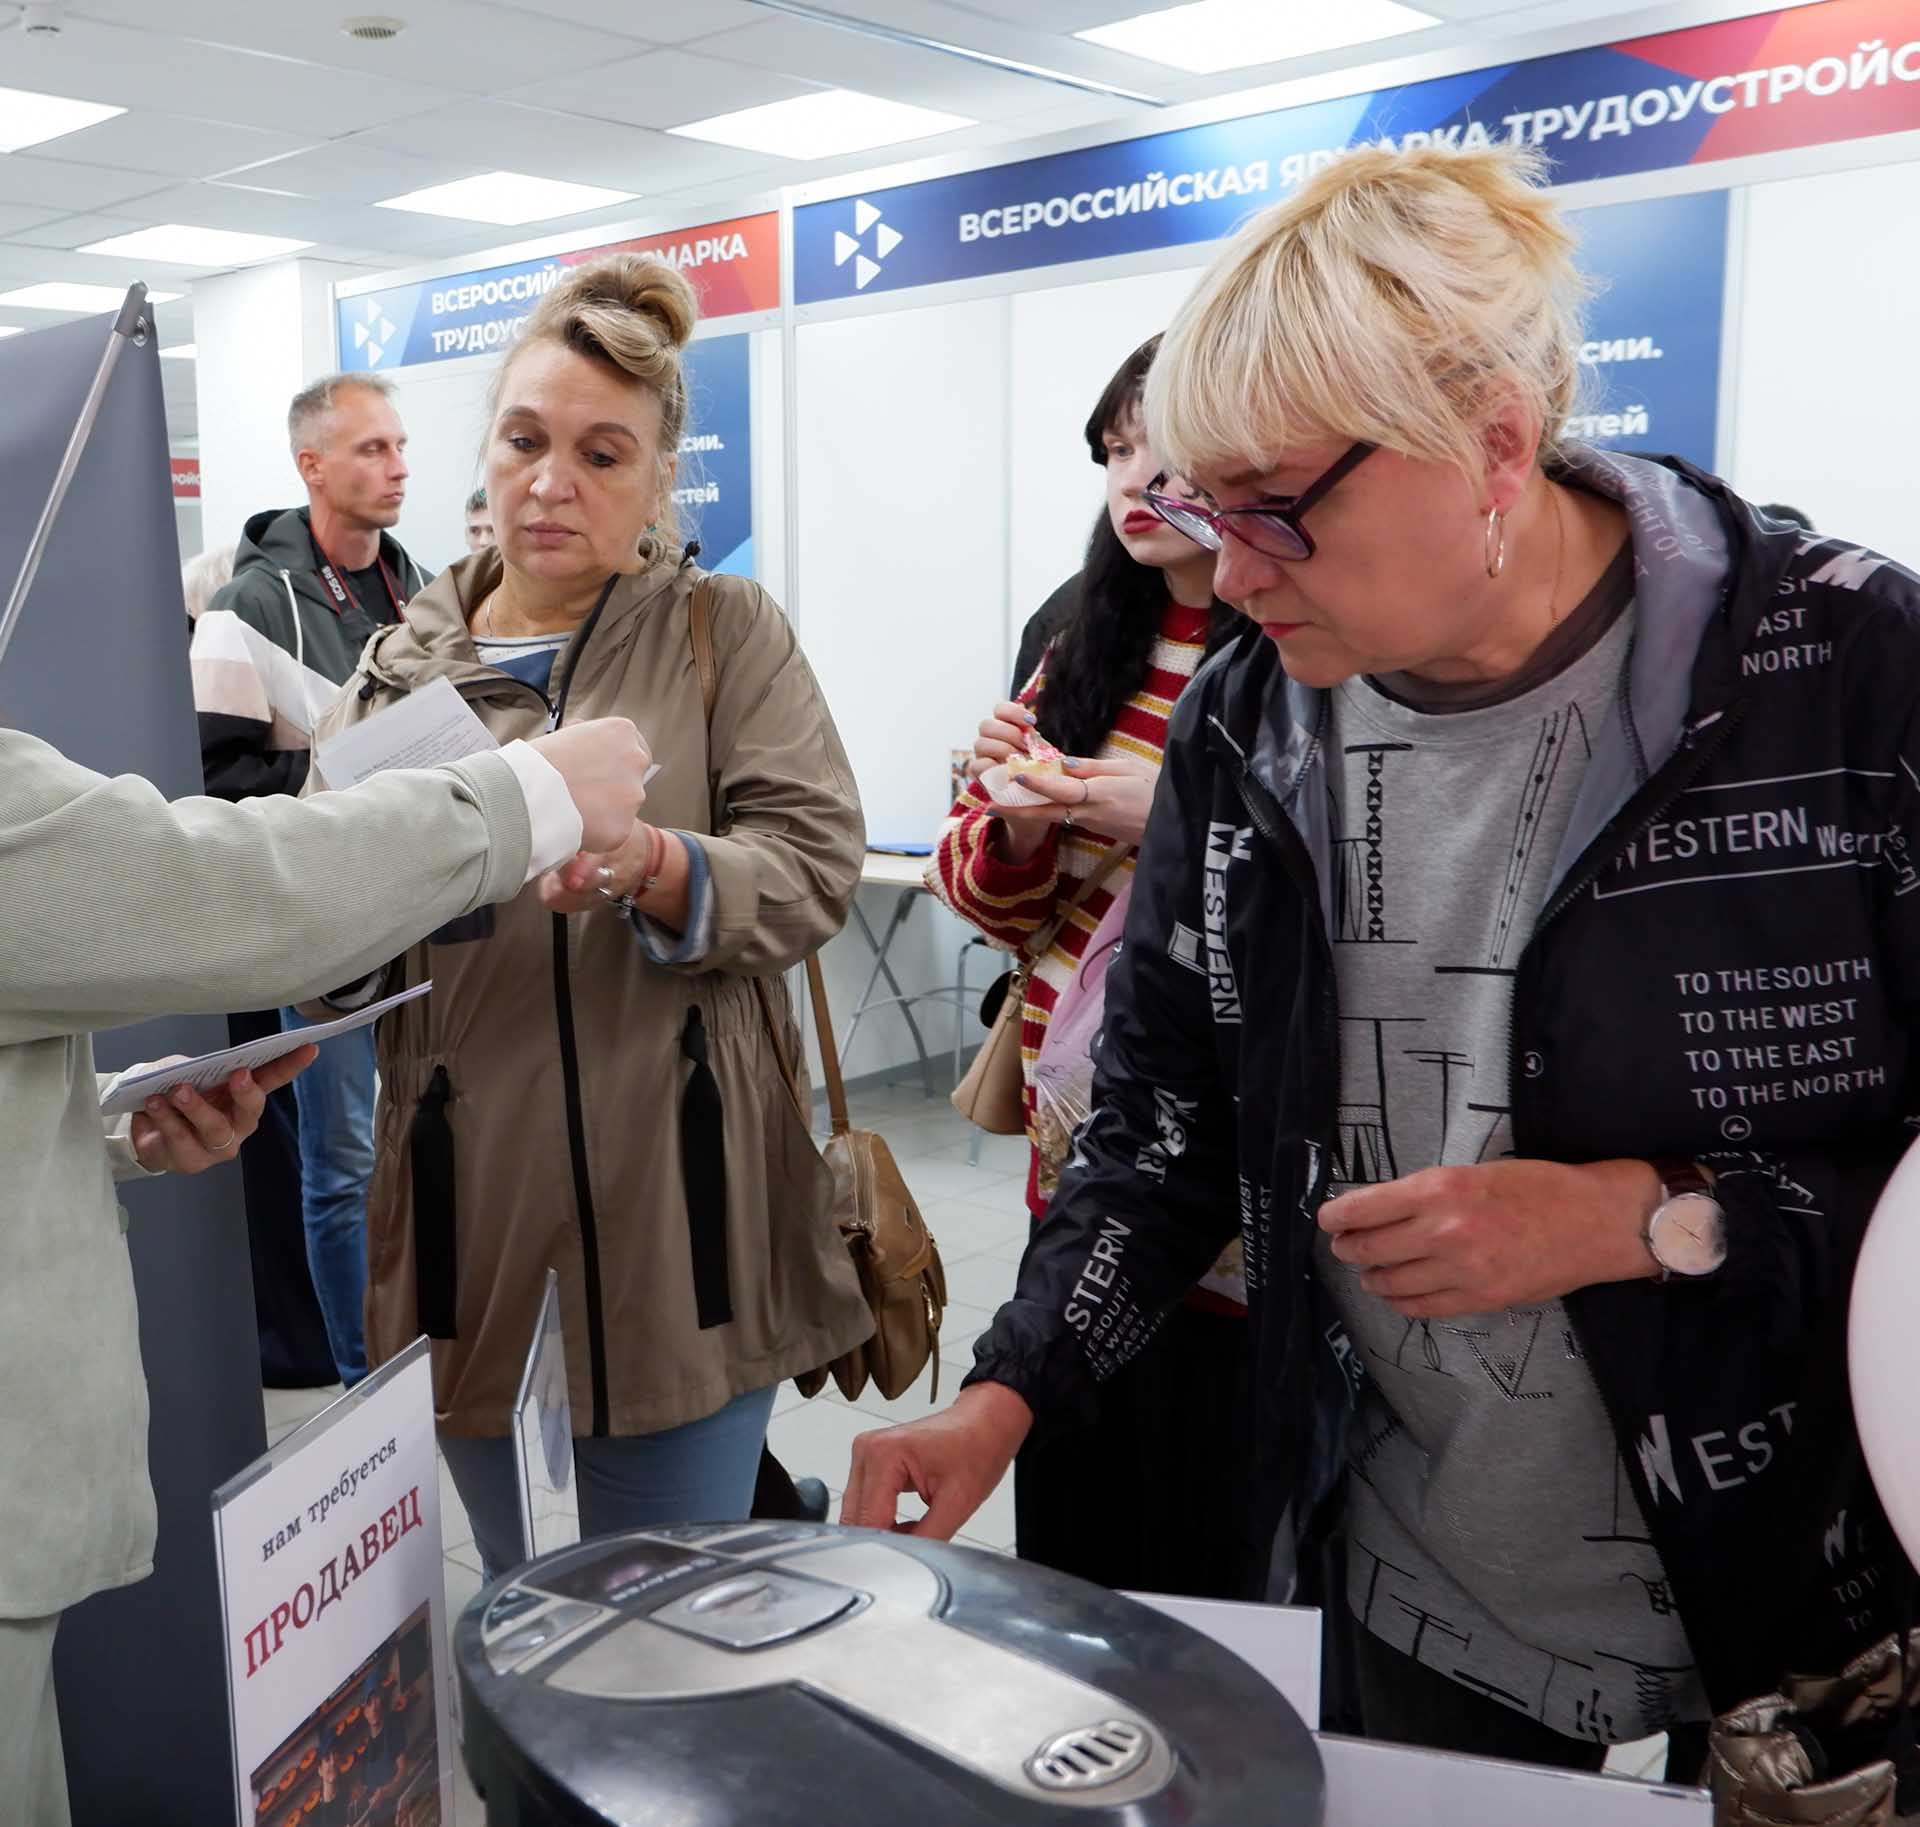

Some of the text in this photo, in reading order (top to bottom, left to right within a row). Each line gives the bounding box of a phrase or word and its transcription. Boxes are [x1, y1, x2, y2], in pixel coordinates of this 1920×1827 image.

[959, 161, 1270, 244] ВСЕРОССИЙСКАЯ
[677, 434, 725, 454] сии.
[1741, 640, 1833, 677] NORTH
[1674, 972, 1711, 996] TO
[1679, 998, 1857, 1035] TO THE WEST
[1684, 1036, 1856, 1073] TO THE EAST
[1691, 1065, 1887, 1110] TO THE NORTH
[261, 1434, 398, 1562] нам требуется
[243, 1484, 424, 1680] ПРОДАВЕЦ
